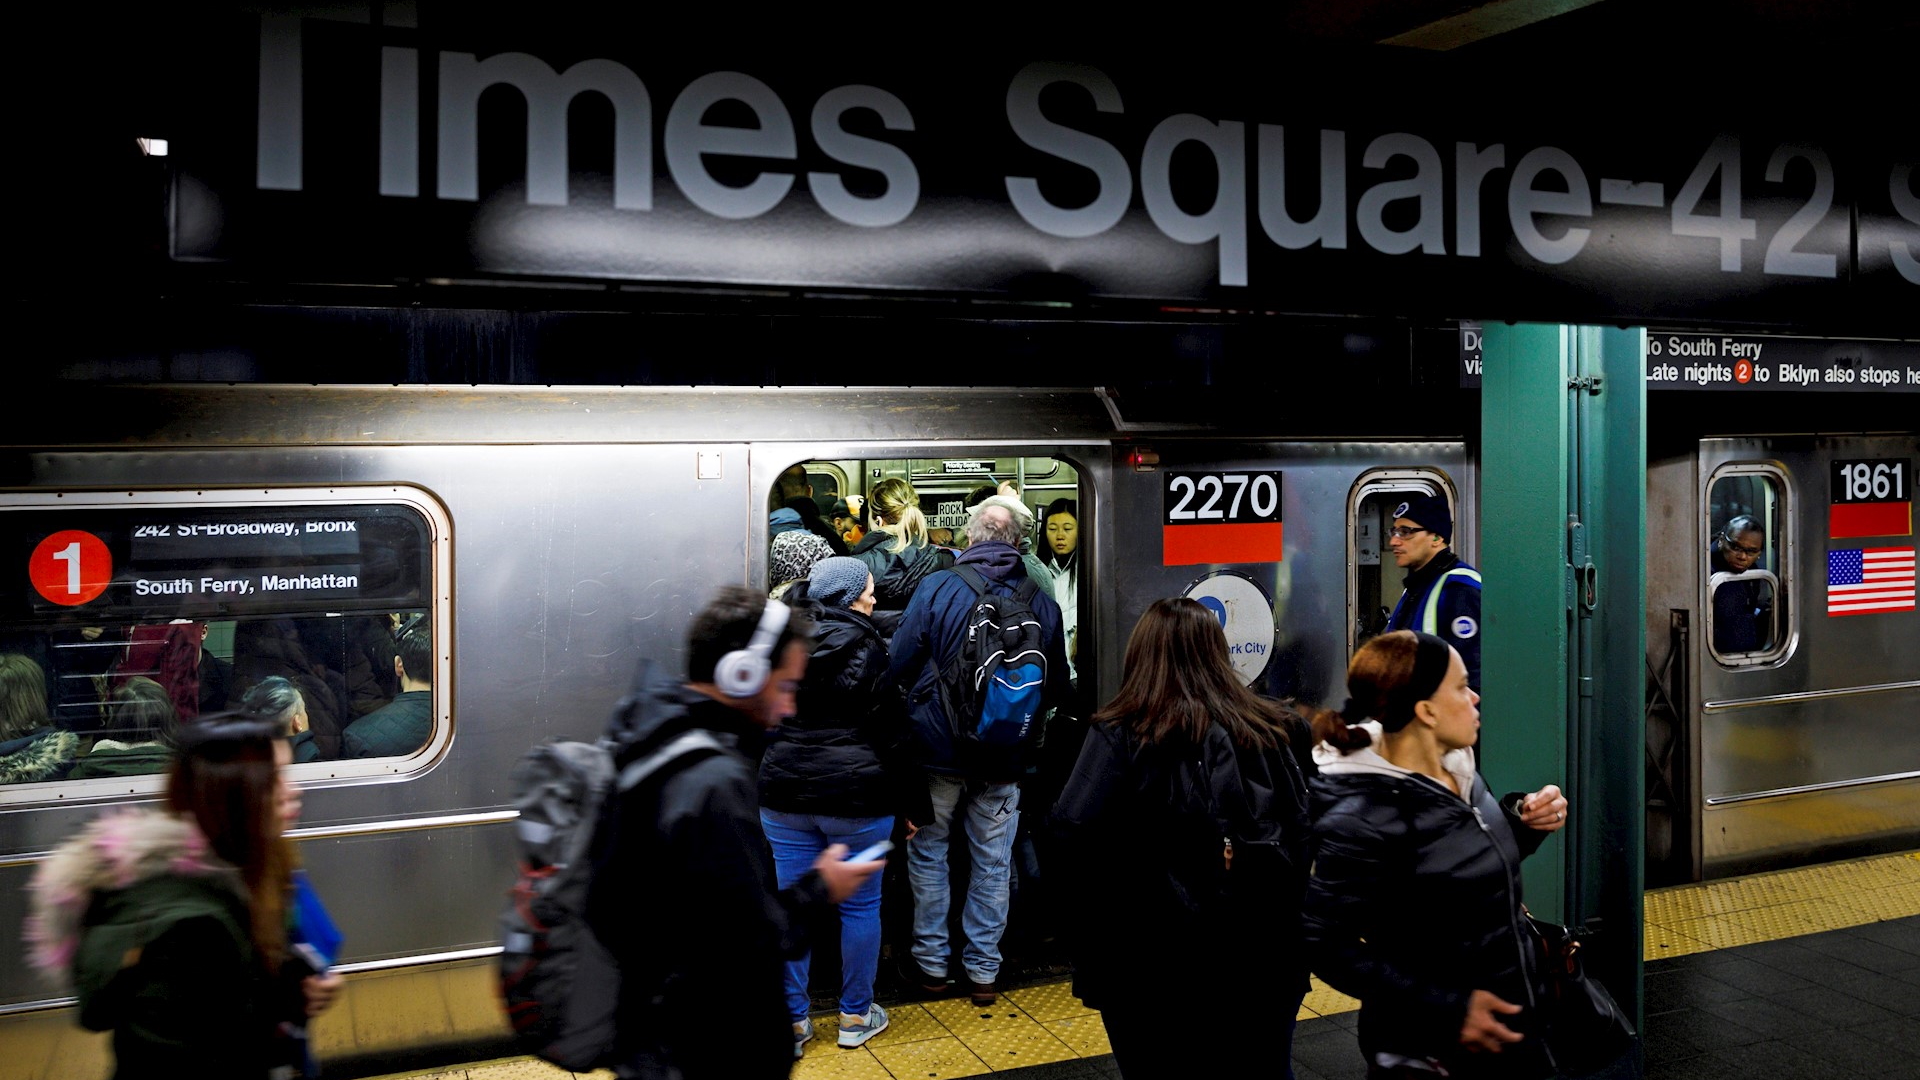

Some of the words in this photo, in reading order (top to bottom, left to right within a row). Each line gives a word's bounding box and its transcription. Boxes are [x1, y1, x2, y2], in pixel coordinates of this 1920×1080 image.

[238, 0, 921, 228] Times
[1004, 61, 1836, 287] Square-42
[1668, 336, 1716, 356] South
[1722, 338, 1762, 360] Ferry
[1684, 362, 1732, 386] nights
[1738, 363, 1747, 379] 2
[1754, 364, 1770, 382] to
[1779, 364, 1819, 386] Bklyn
[1824, 365, 1855, 383] also
[1860, 366, 1900, 387] stops
[1840, 463, 1902, 500] 1861
[1169, 474, 1278, 519] 2270
[940, 504, 962, 514] ROCK
[134, 525, 171, 538] 242
[305, 520, 357, 533] Bronx
[940, 516, 970, 527] HOLIDA
[53, 542, 80, 594] 1
[135, 578, 193, 596] South
[200, 578, 255, 595] Ferry,
[261, 574, 358, 591] Manhattan
[1244, 642, 1267, 656] City
